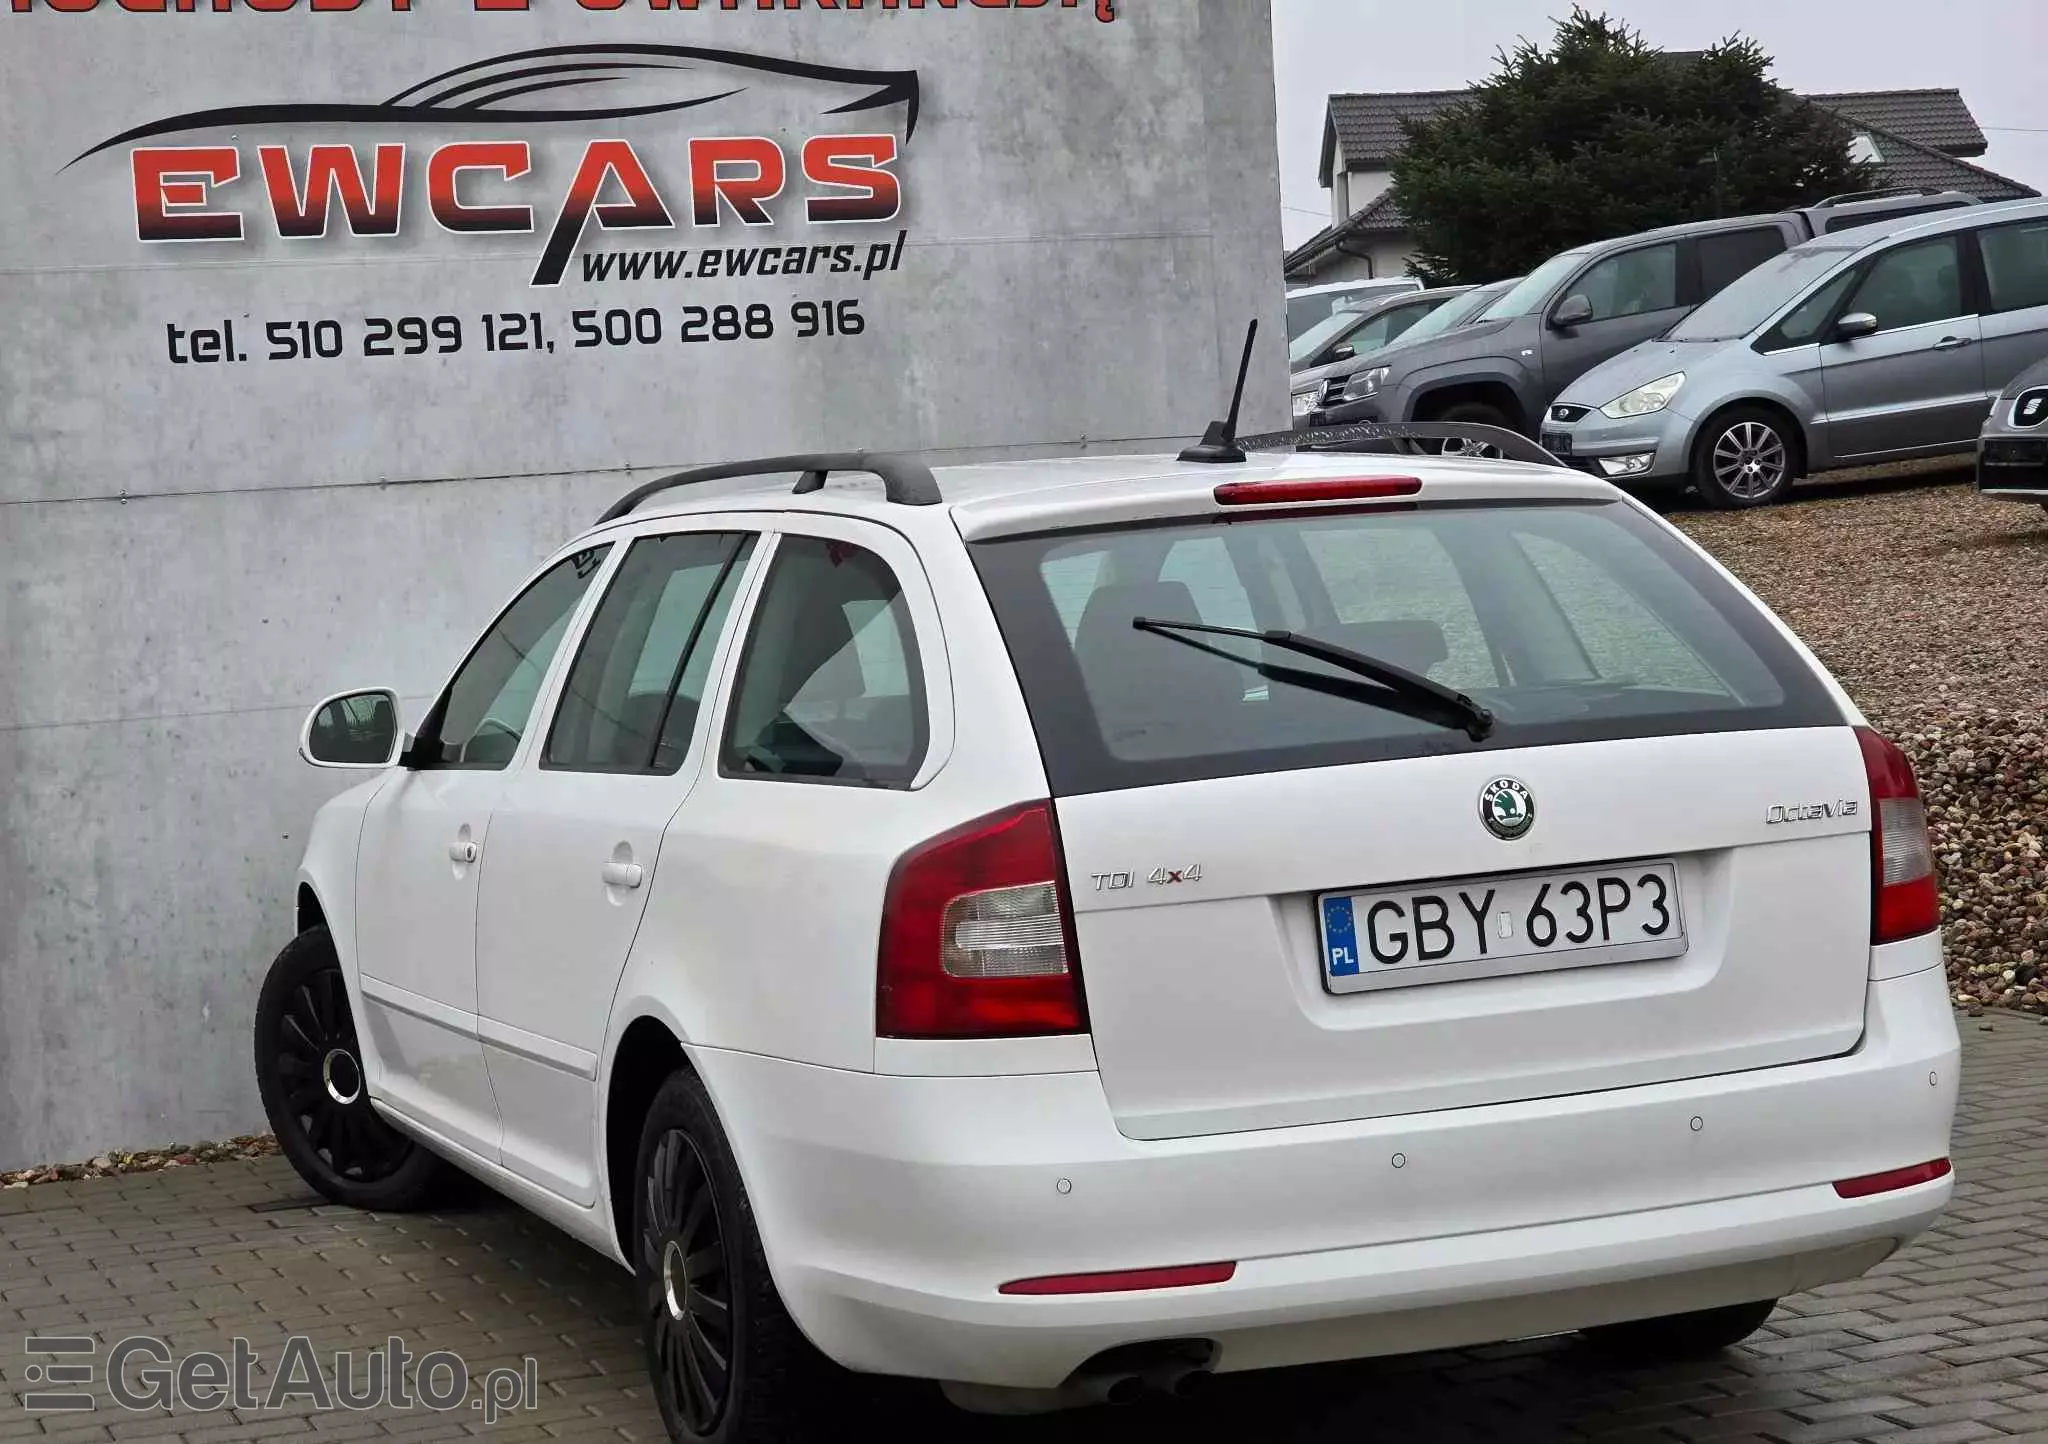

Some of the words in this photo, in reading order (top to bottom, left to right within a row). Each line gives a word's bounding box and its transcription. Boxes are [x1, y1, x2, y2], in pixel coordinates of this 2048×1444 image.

[130, 133, 902, 288] EWCARS
[582, 229, 908, 282] www.ewcars.pl
[166, 319, 247, 364] tel.
[265, 319, 343, 361] 510
[363, 315, 463, 357] 299
[481, 312, 555, 354] 121,
[571, 307, 662, 348] 500
[681, 303, 774, 343] 288
[790, 298, 866, 338] 916
[1766, 799, 1858, 824] Octavia
[1091, 871, 1135, 891] TDI
[1146, 863, 1203, 885] 4x4
[1366, 889, 1496, 965] GBY
[1525, 873, 1671, 948] 63P3
[1331, 947, 1355, 966] PL
